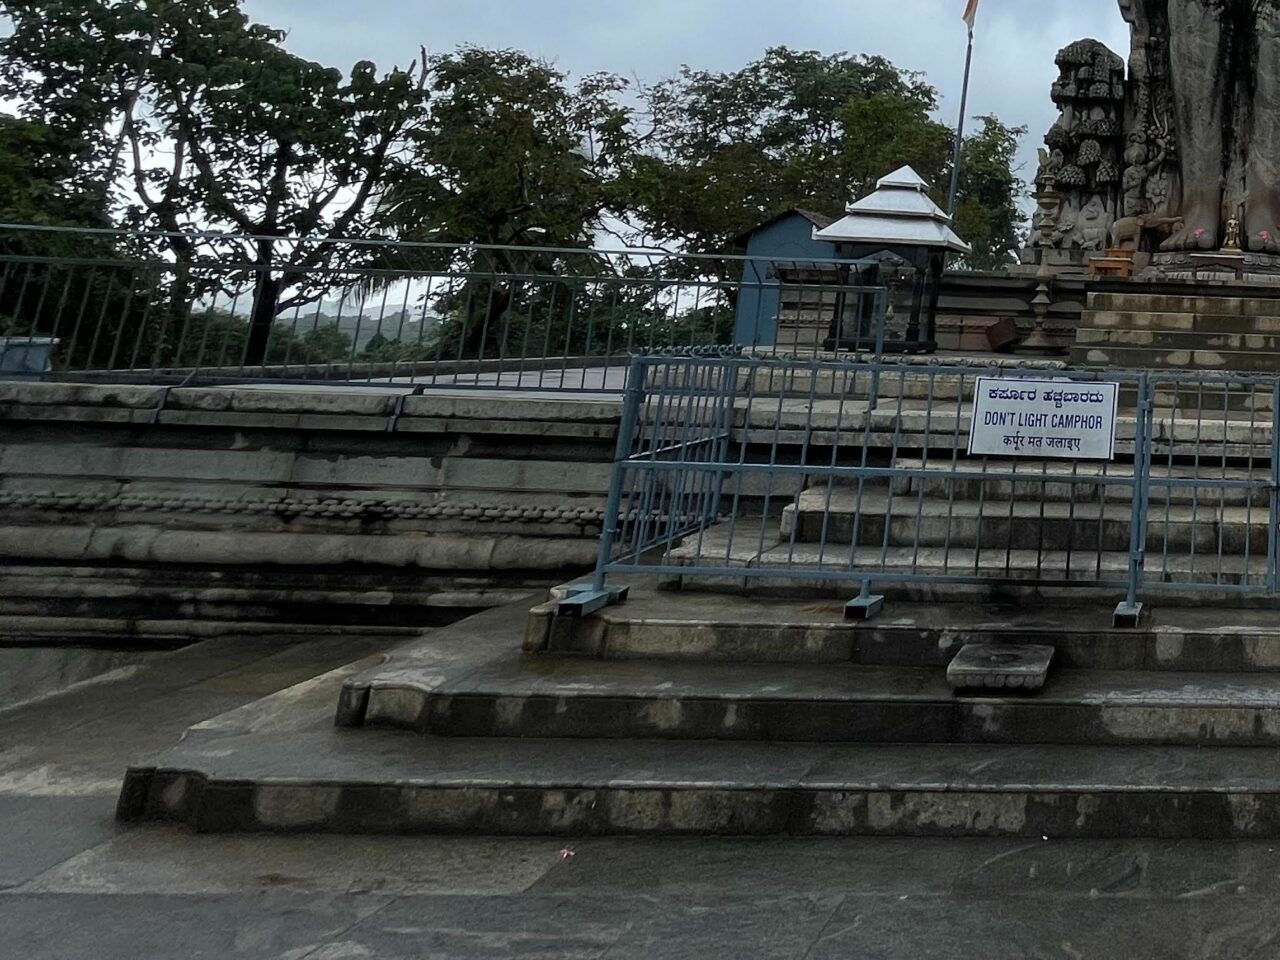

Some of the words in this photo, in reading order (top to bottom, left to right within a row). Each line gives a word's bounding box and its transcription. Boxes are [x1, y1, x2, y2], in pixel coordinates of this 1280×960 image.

[988, 387, 1037, 401] ಕರ್ಪೂರ
[1043, 389, 1104, 408] ಹಚ್ಚಬಾರದು
[984, 411, 1016, 426] DON'T
[1018, 413, 1048, 428] LIGHT
[1051, 414, 1103, 430] CAMPHOR
[1003, 431, 1024, 451] कर्पूर
[1028, 436, 1043, 448] मत
[1046, 437, 1081, 451] जलाइए
